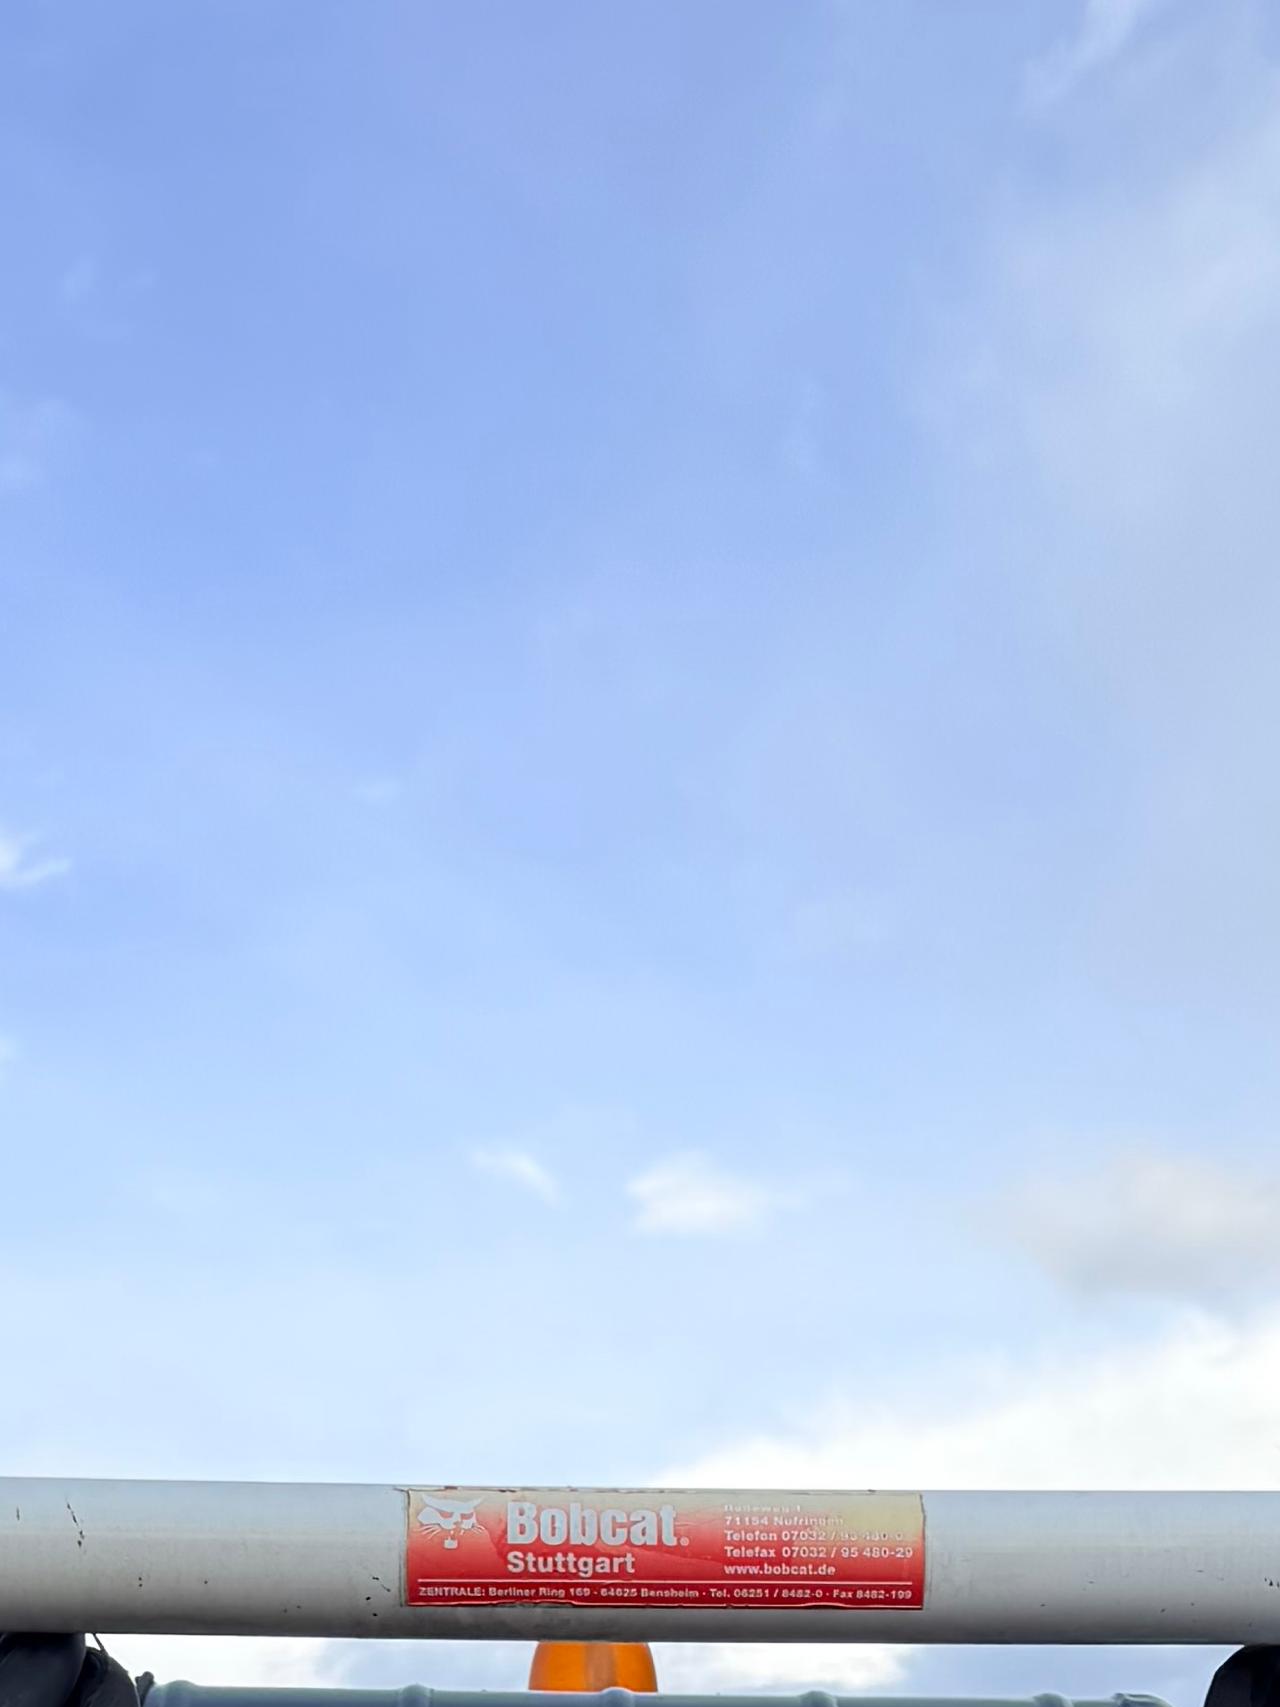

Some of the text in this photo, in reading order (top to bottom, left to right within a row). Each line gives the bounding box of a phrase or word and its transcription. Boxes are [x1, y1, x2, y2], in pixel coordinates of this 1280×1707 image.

[507, 1501, 679, 1546] Bobcat
[724, 1516, 769, 1526] 71154
[724, 1530, 777, 1541] Telefon
[782, 1530, 825, 1541] 07032
[724, 1546, 776, 1558] Telefax
[782, 1547, 827, 1559] 07032
[841, 1547, 858, 1559] 95
[863, 1547, 913, 1559] 480-29
[507, 1551, 635, 1578] Stuttgart
[724, 1563, 835, 1576] www.bobcat.de
[418, 1586, 485, 1597] ZENTRALE:
[488, 1586, 535, 1597] Berliner
[539, 1586, 566, 1598] Ring
[570, 1587, 591, 1597] 169
[640, 1588, 699, 1598] Bensheim
[709, 1588, 730, 1598] Tel.
[734, 1588, 769, 1598] 06251
[833, 1589, 853, 1599] Fax
